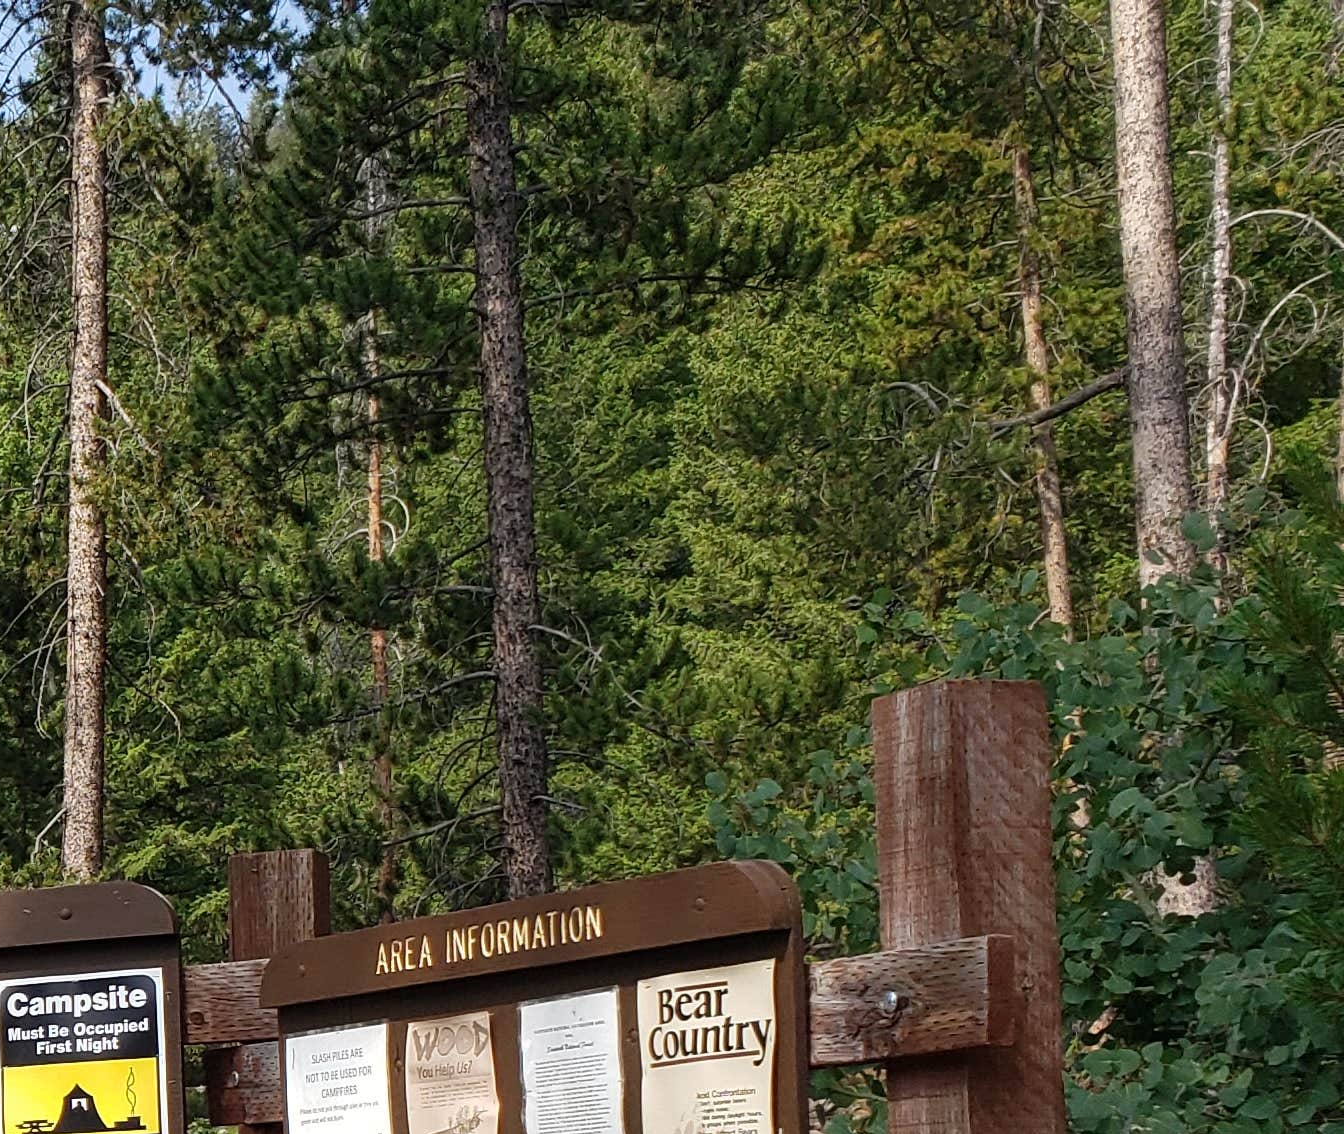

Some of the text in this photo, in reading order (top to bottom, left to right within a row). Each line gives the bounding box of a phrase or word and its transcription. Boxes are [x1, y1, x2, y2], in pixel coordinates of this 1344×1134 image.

[375, 905, 603, 975] AREA INFORMATION
[7, 985, 147, 1017] Campsite
[657, 988, 728, 1024] Bear
[8, 1018, 149, 1041] Must Be Occupied
[413, 1021, 488, 1061] WOOD
[649, 1016, 772, 1066] Country
[36, 1037, 119, 1055] First Night
[312, 1048, 363, 1064] SLASH PILES ARE
[306, 1066, 372, 1083] NOT TO BE USED FOR
[417, 1066, 433, 1079] You
[435, 1064, 455, 1078] Help
[322, 1085, 357, 1098] CAMPFIRES
